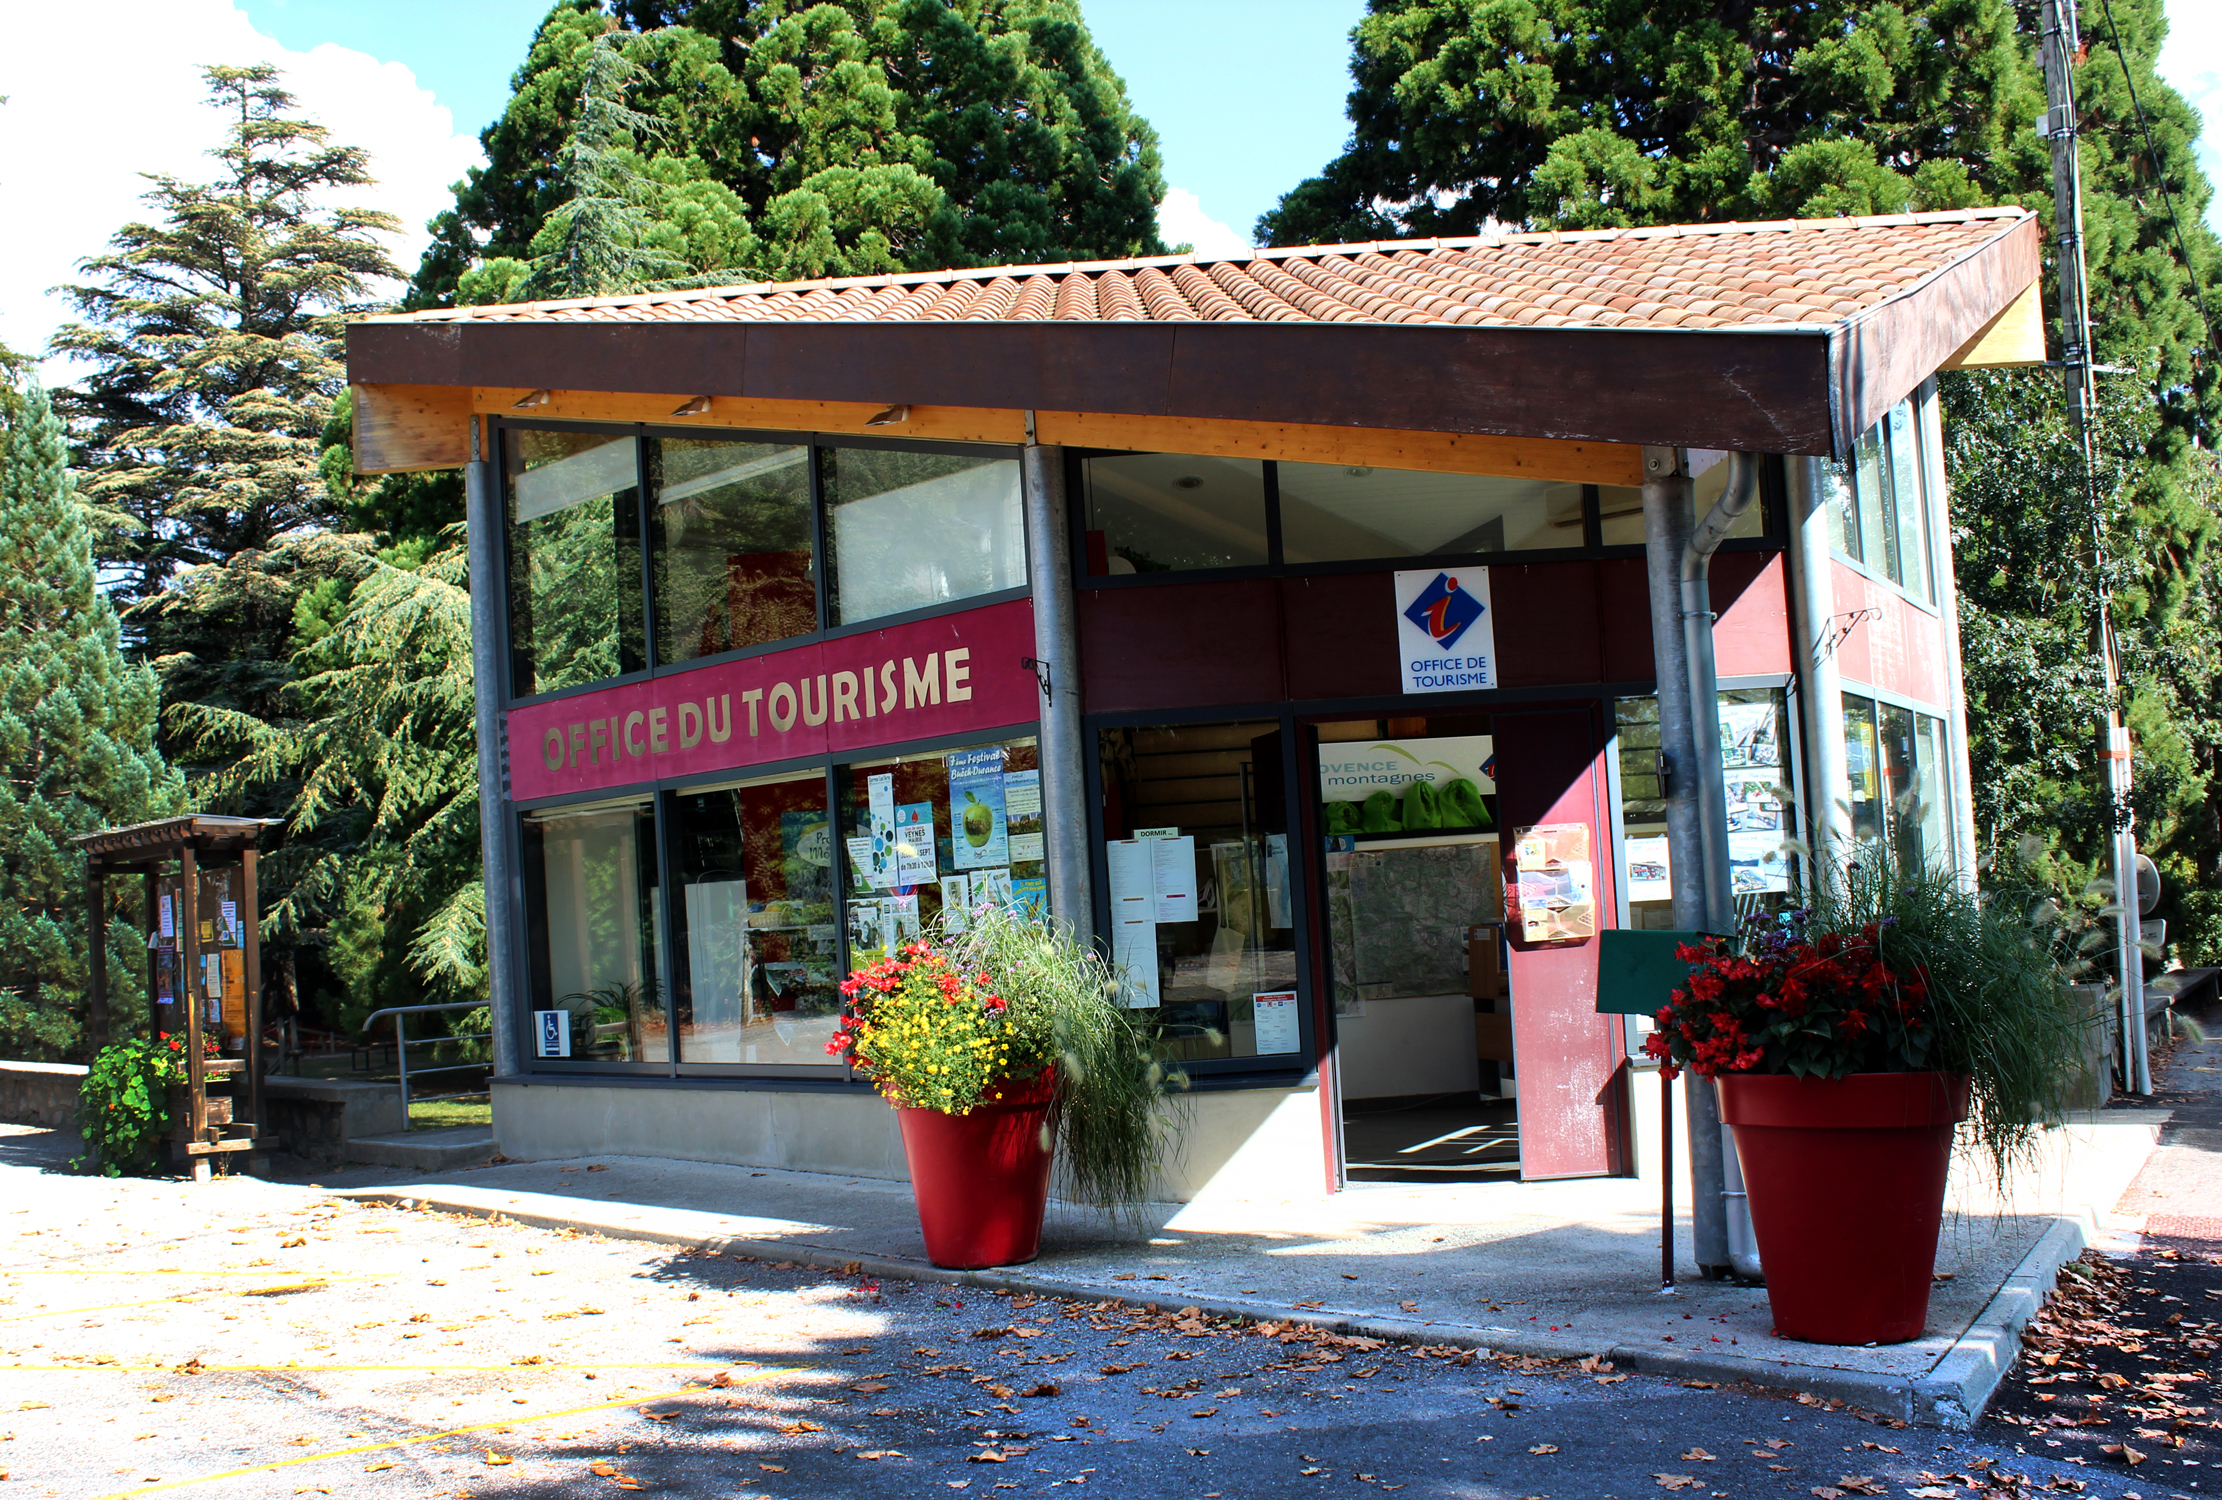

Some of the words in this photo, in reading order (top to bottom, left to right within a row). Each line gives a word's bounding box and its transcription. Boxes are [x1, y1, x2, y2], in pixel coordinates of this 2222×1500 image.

[1411, 658, 1463, 673] OFFICE
[1467, 656, 1487, 669] DE
[1412, 672, 1488, 688] TOURISME
[542, 706, 669, 772] OFFICE
[678, 694, 732, 749] DU
[742, 647, 972, 737] TOURISME
[967, 749, 1001, 764] Festival
[1320, 761, 1398, 775] OVENCE
[1328, 772, 1437, 786] montagnes
[904, 829, 926, 838] VEYNES
[1140, 829, 1167, 837] DORMIR
[919, 848, 933, 856] SEPT.
